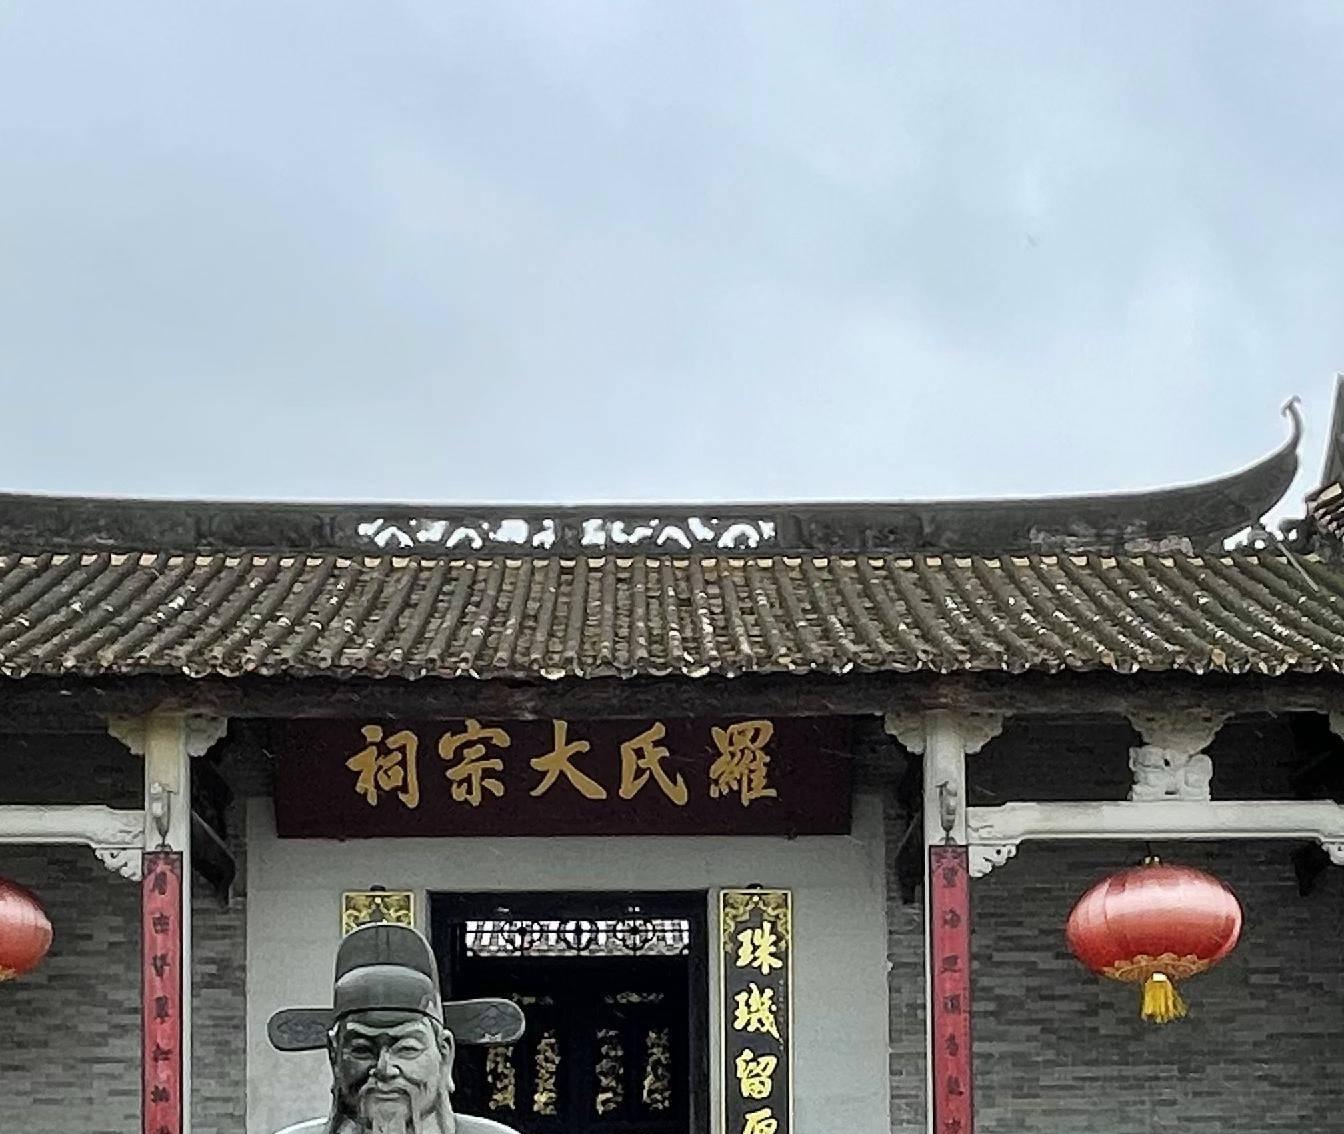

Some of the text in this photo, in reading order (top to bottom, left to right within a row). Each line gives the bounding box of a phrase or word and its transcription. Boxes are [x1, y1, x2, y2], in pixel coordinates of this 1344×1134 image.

[346, 719, 780, 809] 羅氏大宗祠
